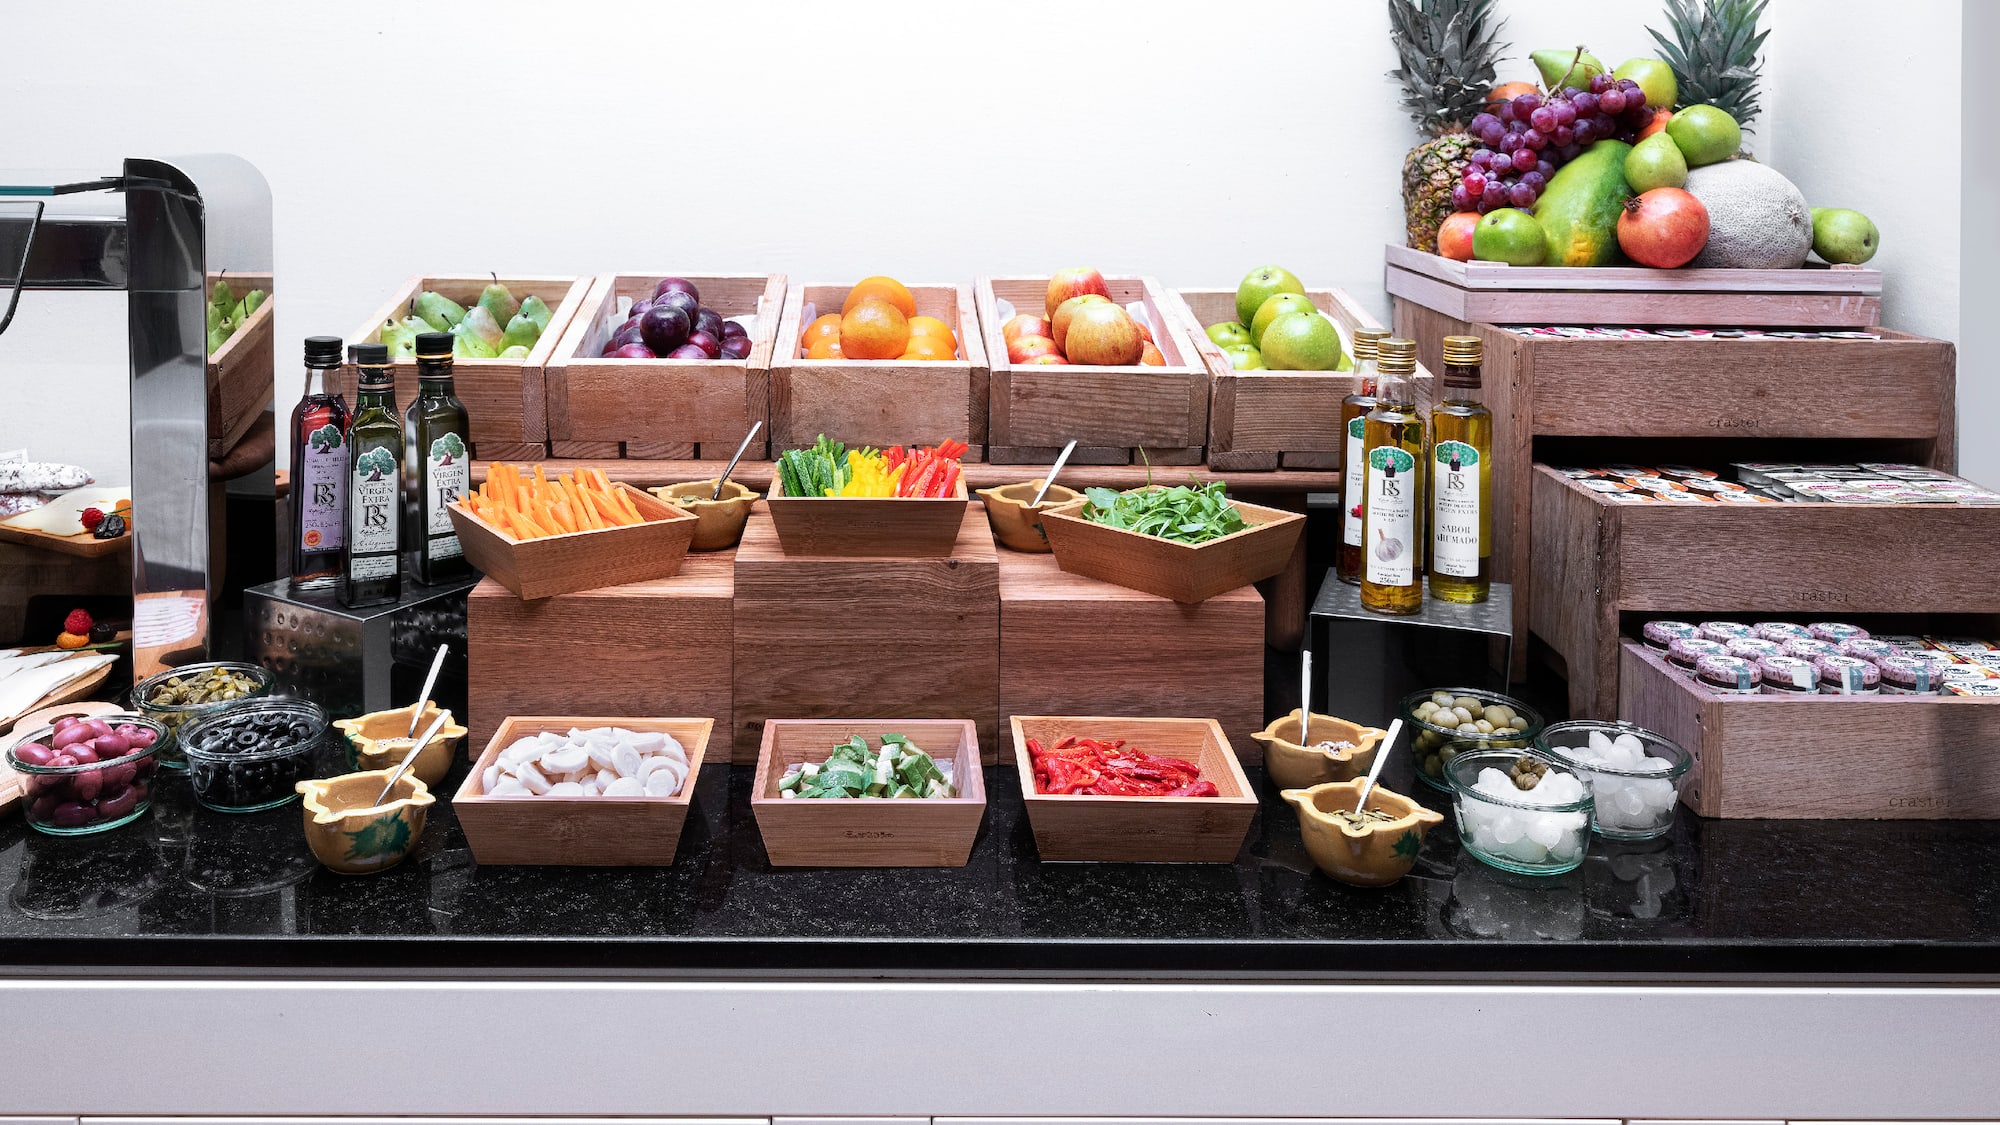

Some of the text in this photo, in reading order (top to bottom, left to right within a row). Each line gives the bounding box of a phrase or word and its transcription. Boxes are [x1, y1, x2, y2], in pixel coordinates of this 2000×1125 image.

[1708, 418, 1759, 428] craster
[432, 469, 464, 479] VIRGEN
[436, 479, 461, 488] EXTRA
[358, 486, 394, 495] VIRGEN
[362, 495, 390, 504] EXTRA
[1441, 523, 1471, 534] SABOR
[1436, 533, 1479, 544] AHUMADO
[1889, 797, 1951, 808] craster
